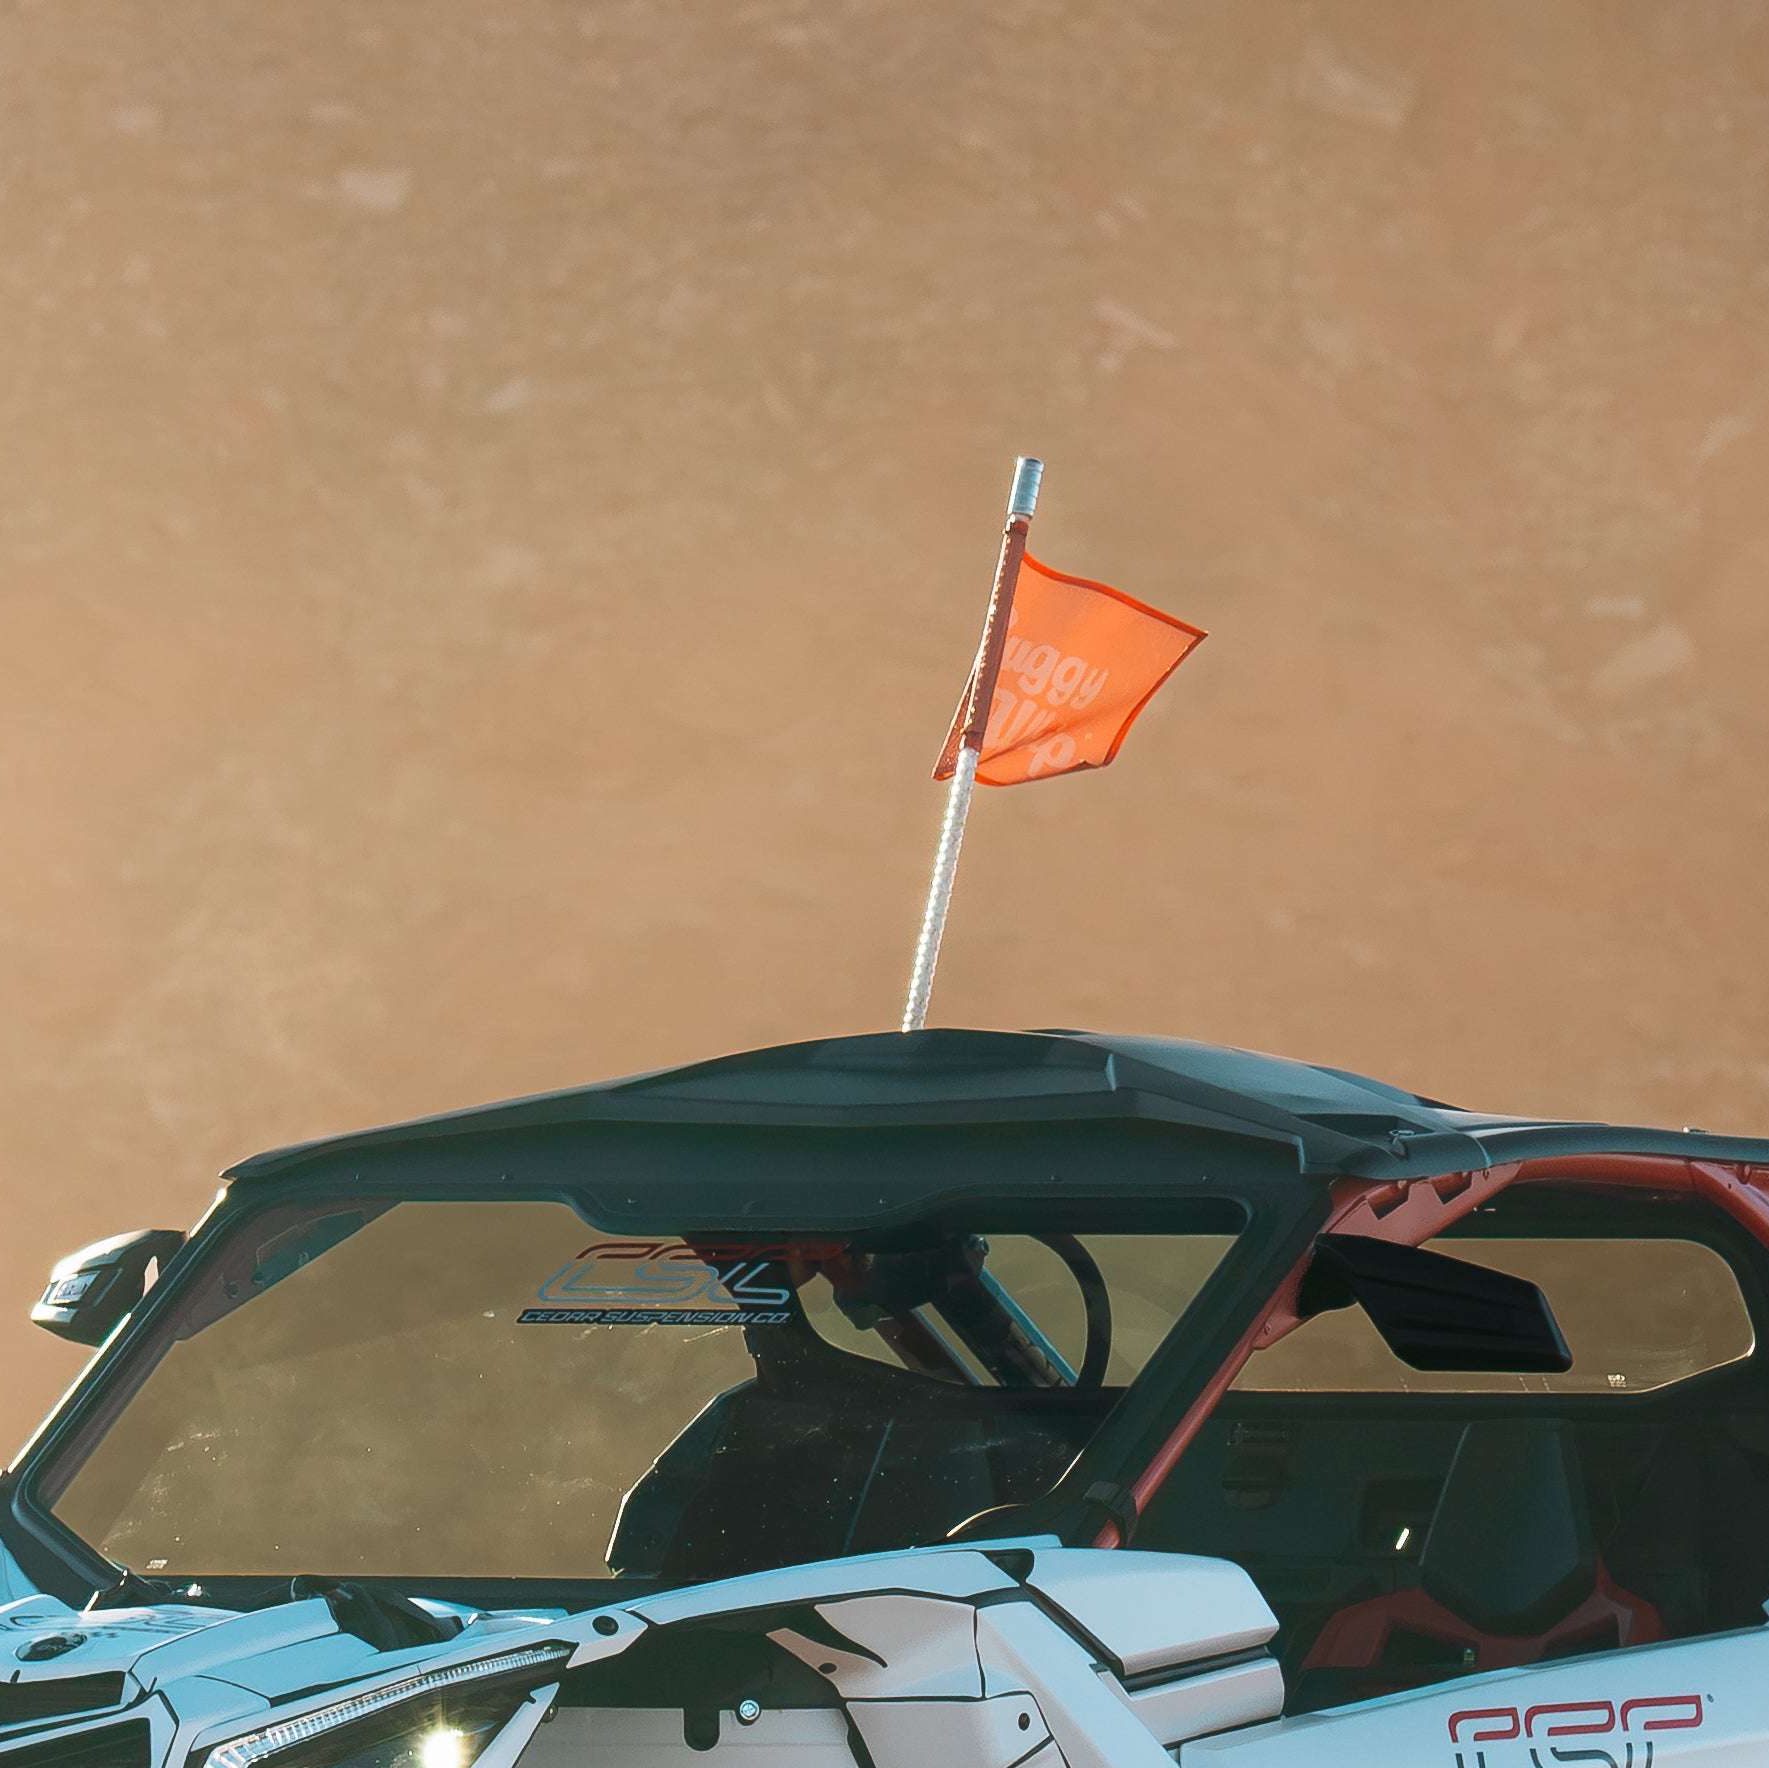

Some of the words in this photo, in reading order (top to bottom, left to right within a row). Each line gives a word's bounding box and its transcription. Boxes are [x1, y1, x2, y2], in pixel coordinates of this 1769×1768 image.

[999, 630, 1109, 709] uggy
[519, 1311, 599, 1325] CEDAR
[602, 1311, 753, 1325] SUSPENSION
